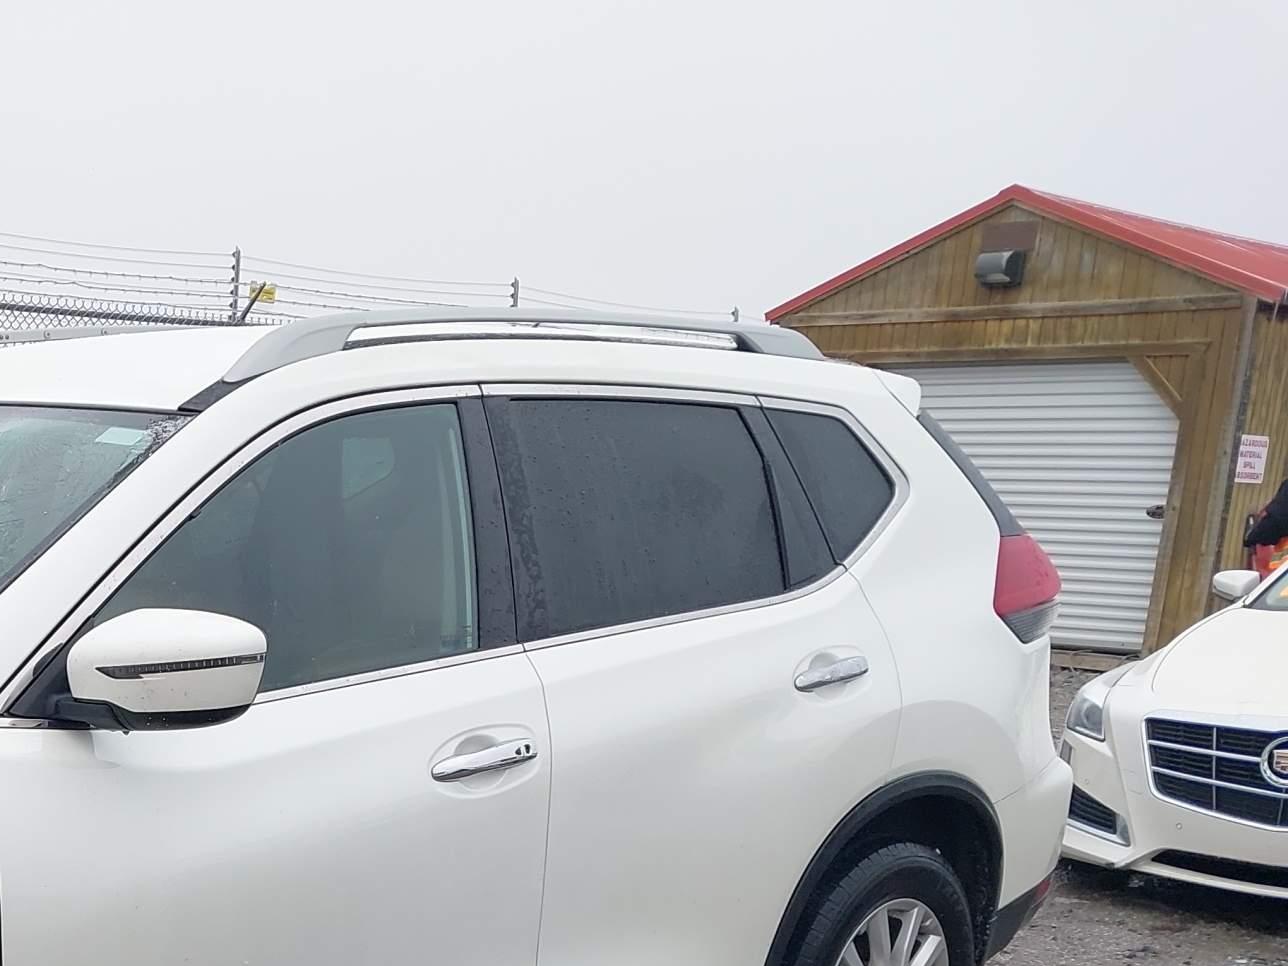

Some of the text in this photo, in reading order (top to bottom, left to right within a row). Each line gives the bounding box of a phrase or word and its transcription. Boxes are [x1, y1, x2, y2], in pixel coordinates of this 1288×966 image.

[1241, 438, 1268, 448] AZARDOUS
[1239, 450, 1263, 459] MATERIAL
[1243, 461, 1256, 469] SPILL
